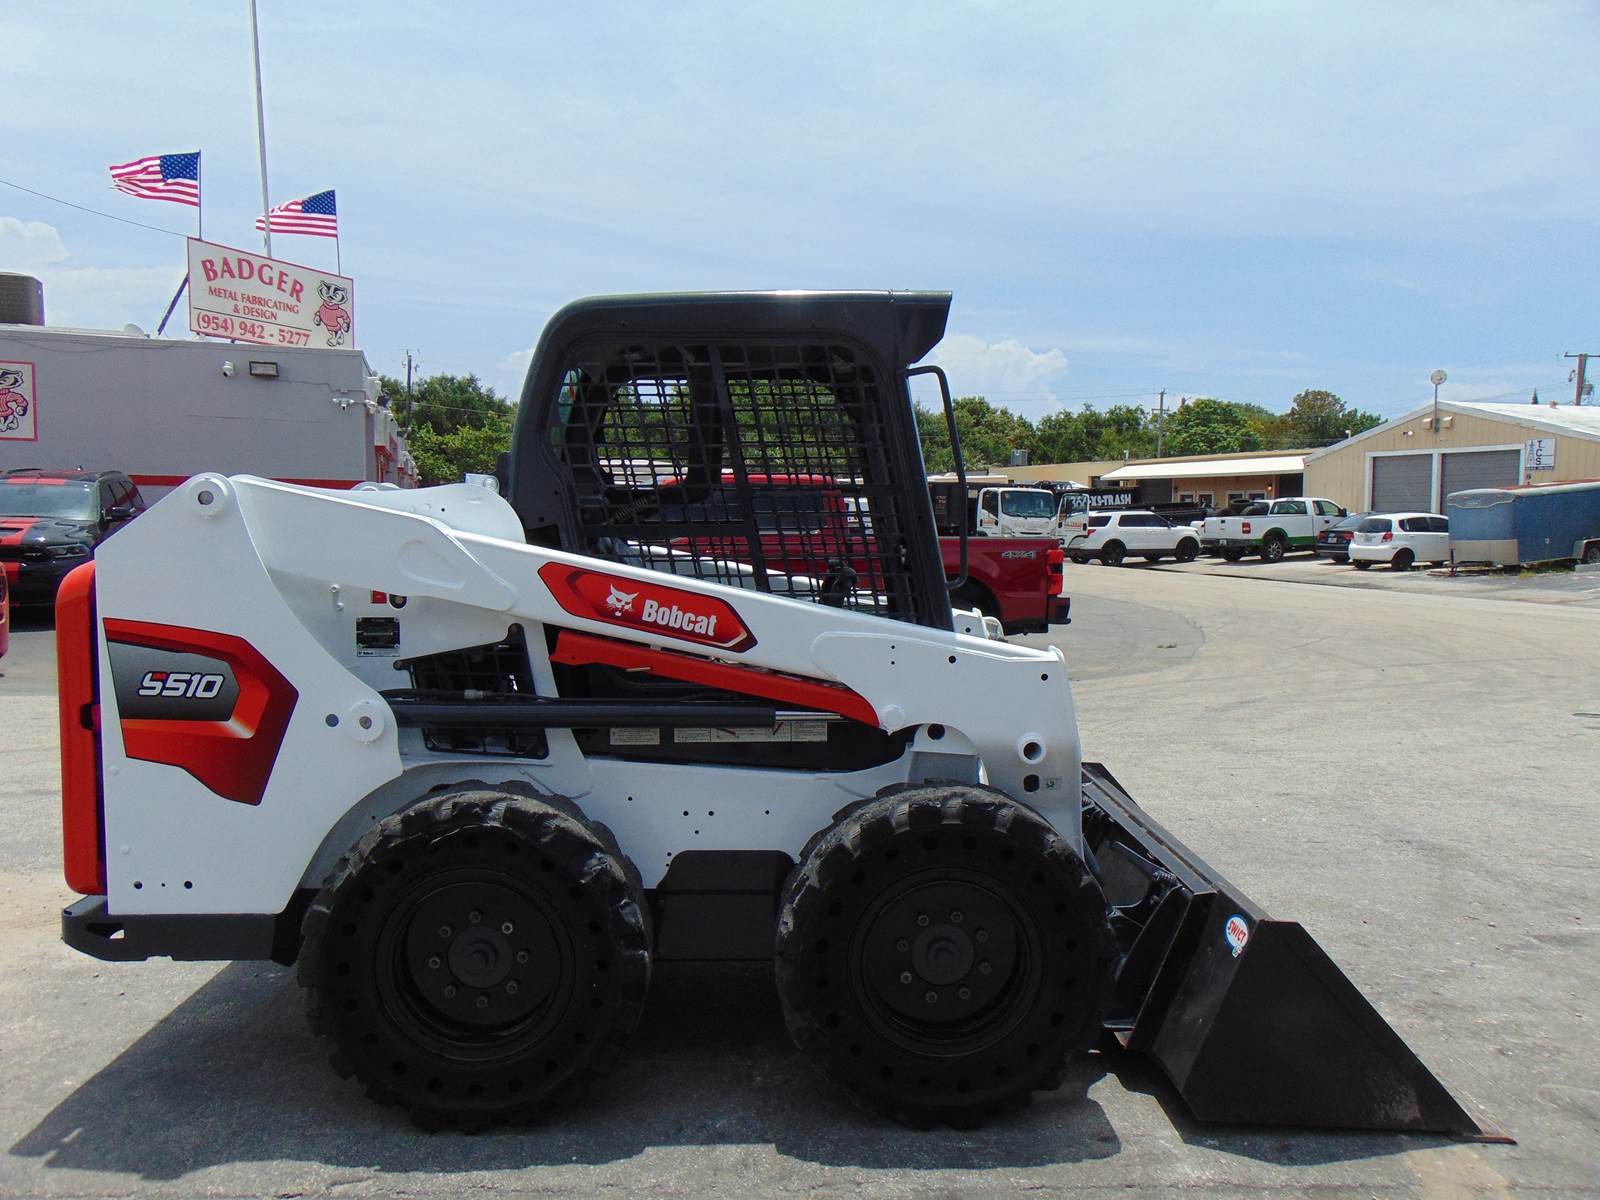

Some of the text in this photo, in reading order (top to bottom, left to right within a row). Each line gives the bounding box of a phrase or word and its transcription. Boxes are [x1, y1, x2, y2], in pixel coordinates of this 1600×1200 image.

[201, 256, 304, 303] BADGER
[208, 286, 299, 314] METAL FABRICATING
[233, 304, 278, 321] & DESIGN
[196, 312, 234, 334] (954)
[239, 321, 265, 339] 942
[278, 328, 311, 347] 5277
[642, 599, 717, 636] Bobcat
[138, 672, 224, 698] S510
